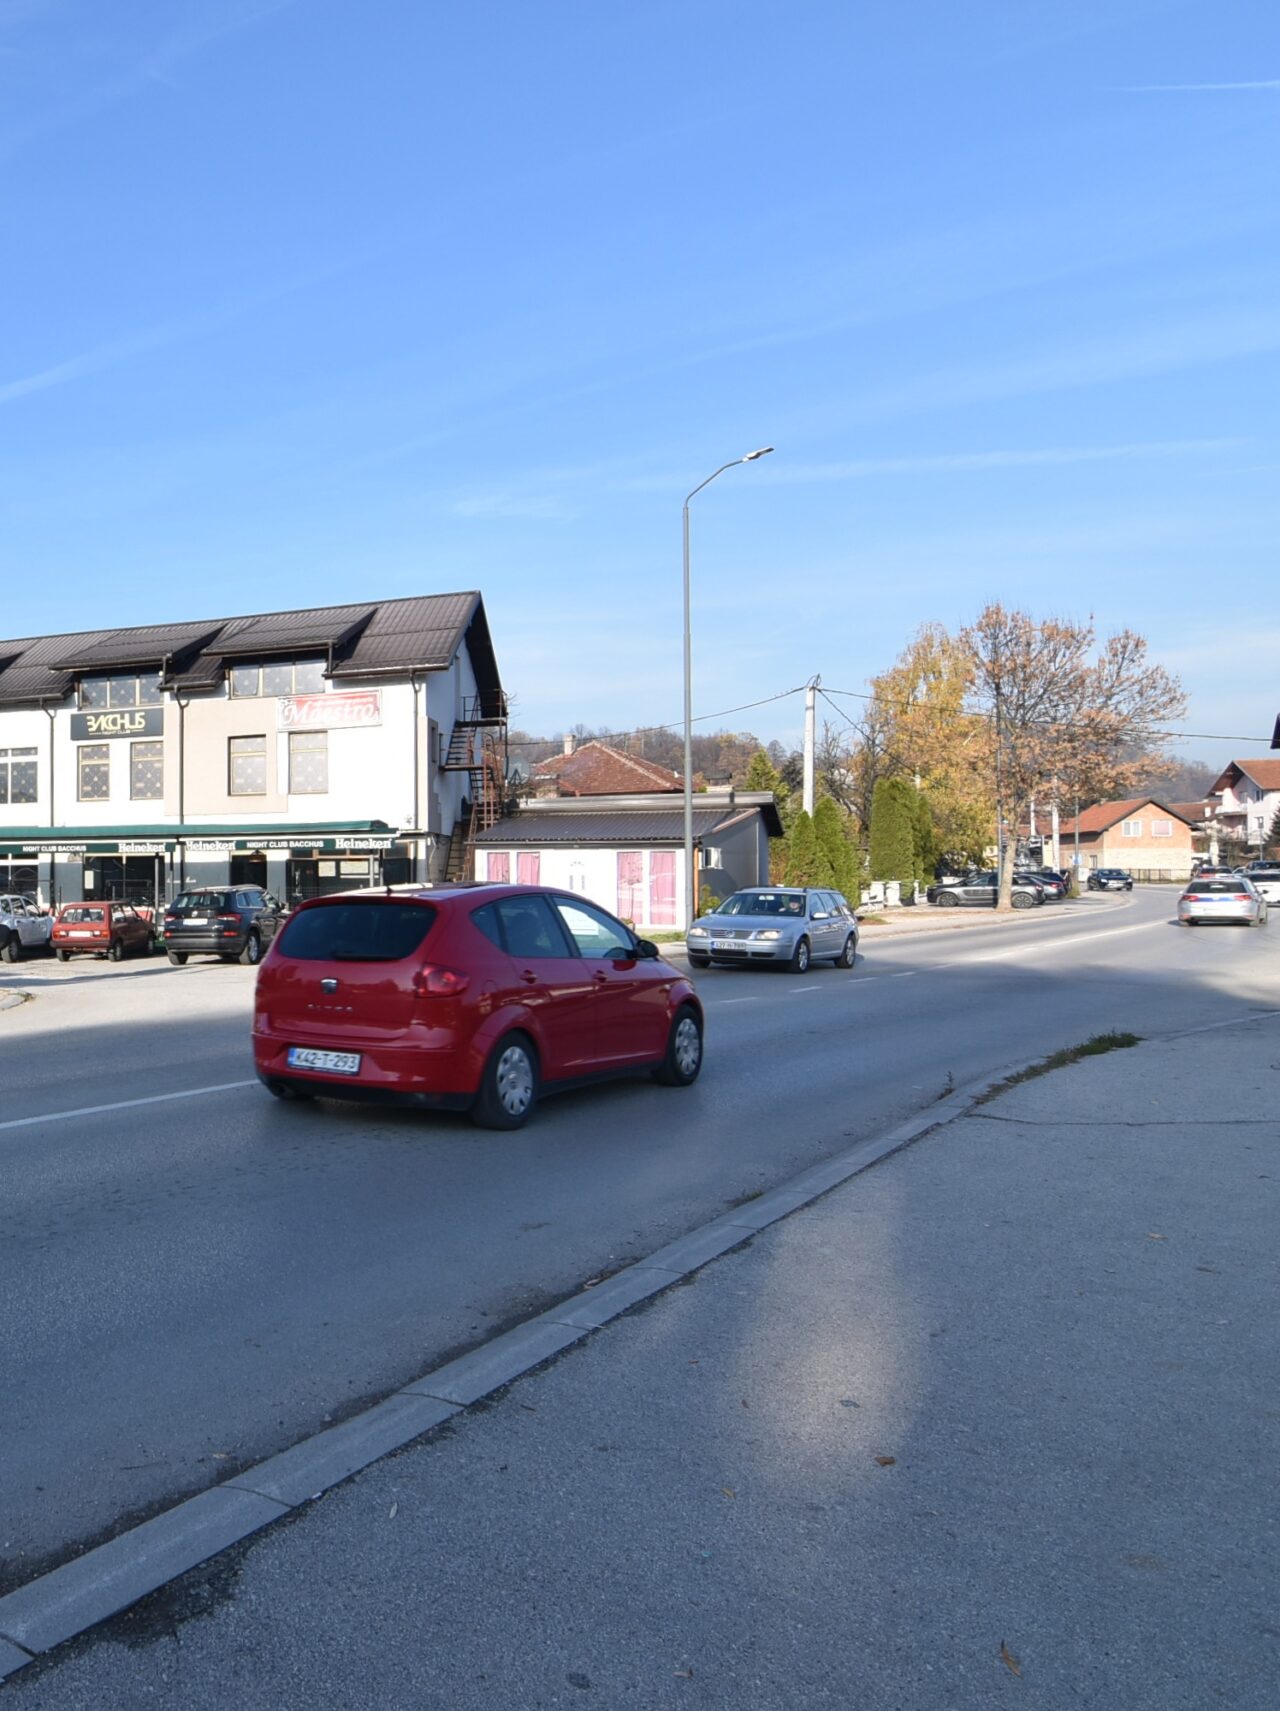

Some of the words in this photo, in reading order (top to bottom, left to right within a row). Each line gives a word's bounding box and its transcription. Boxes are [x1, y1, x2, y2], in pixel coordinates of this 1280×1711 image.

[283, 700, 376, 724] Maestro
[86, 712, 145, 732] BACCHUS
[118, 842, 166, 853] Heineken
[186, 840, 237, 851] Heineken
[246, 841, 268, 849] NIGHT
[289, 840, 324, 848] BACCHUS
[335, 838, 392, 849] Heineken
[296, 1050, 357, 1069] K42-T-293
